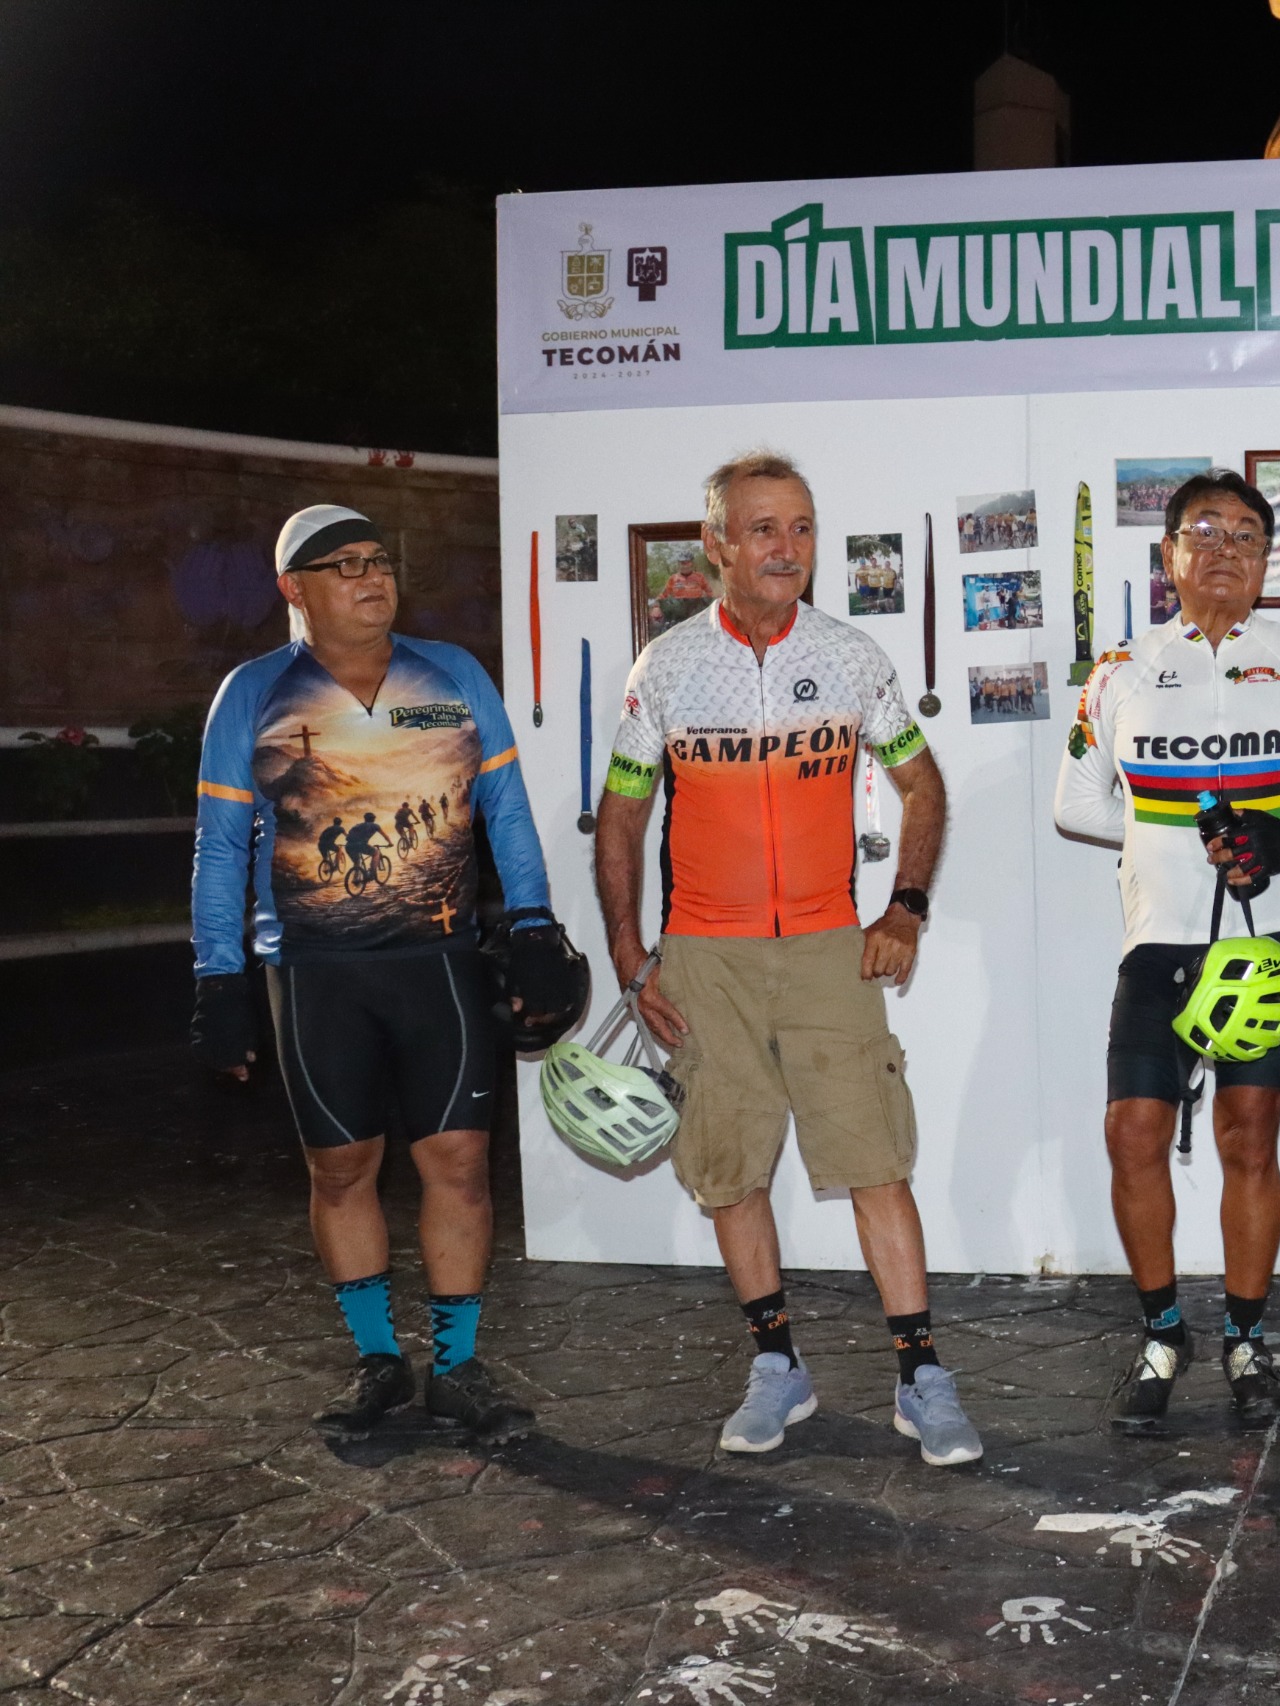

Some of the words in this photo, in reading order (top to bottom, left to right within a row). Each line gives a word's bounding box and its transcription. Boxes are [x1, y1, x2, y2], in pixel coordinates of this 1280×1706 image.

[736, 216, 861, 336] DÍA
[887, 222, 1241, 329] MUNDIAL
[541, 329, 608, 342] GOBIERNO
[611, 326, 680, 338] MUNICIPAL
[541, 339, 681, 367] TECOMÁN
[1076, 551, 1084, 587] Comex
[430, 713, 457, 722] Talpa
[686, 726, 748, 735] Veteranos
[672, 720, 853, 762] CAMPEÓN
[797, 755, 848, 780] MTB
